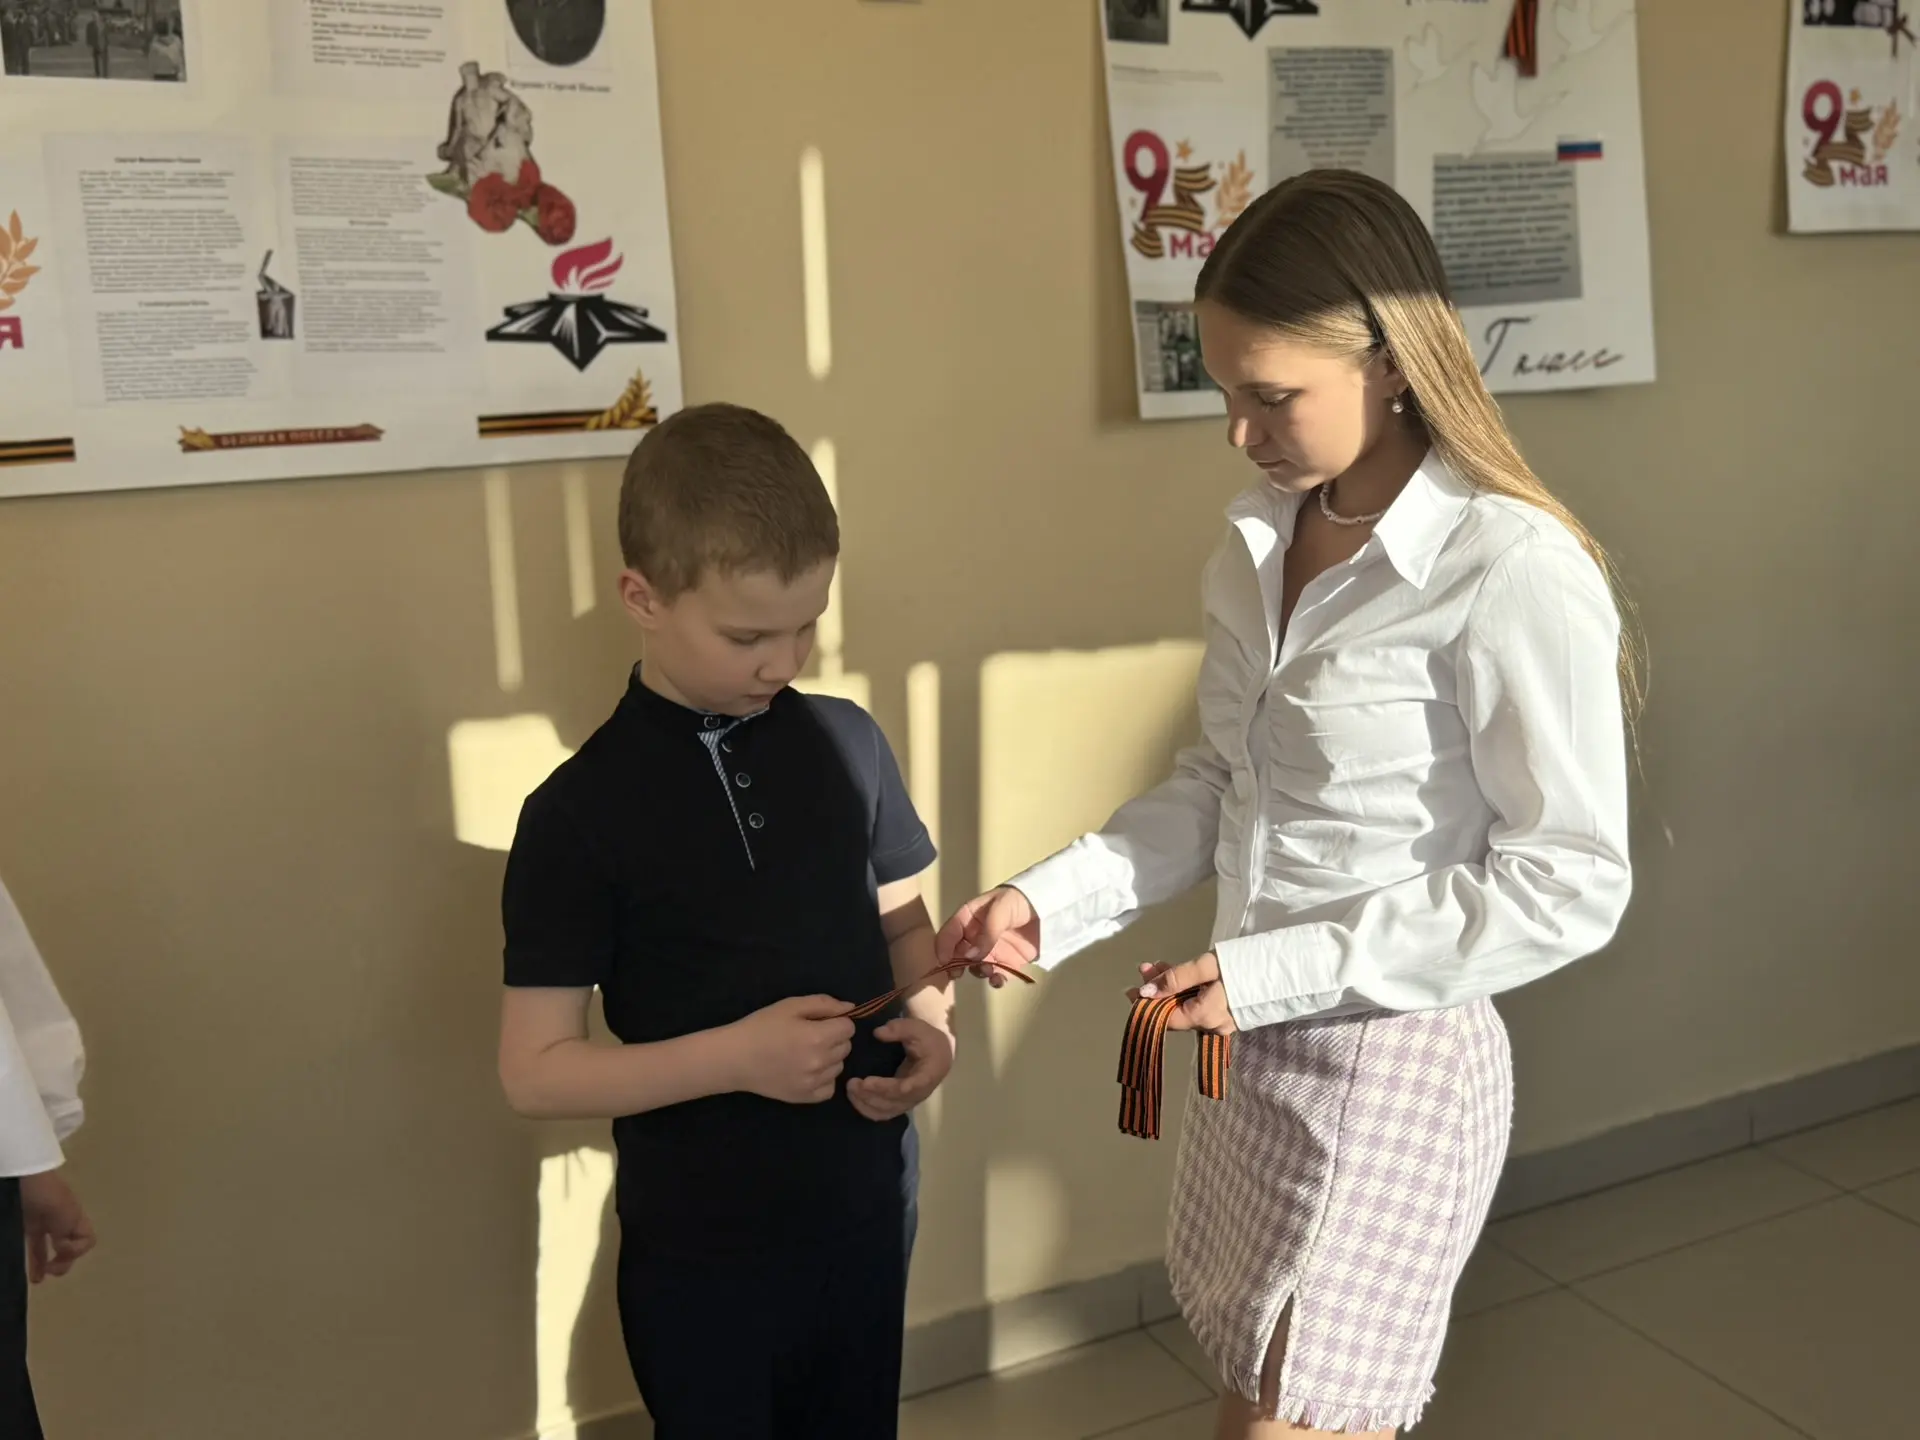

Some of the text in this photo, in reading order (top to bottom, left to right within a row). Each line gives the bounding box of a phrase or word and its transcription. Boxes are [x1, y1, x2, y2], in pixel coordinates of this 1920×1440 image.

[1803, 79, 1843, 158] 9
[1123, 130, 1170, 223] 9
[1169, 231, 1216, 259] ма
